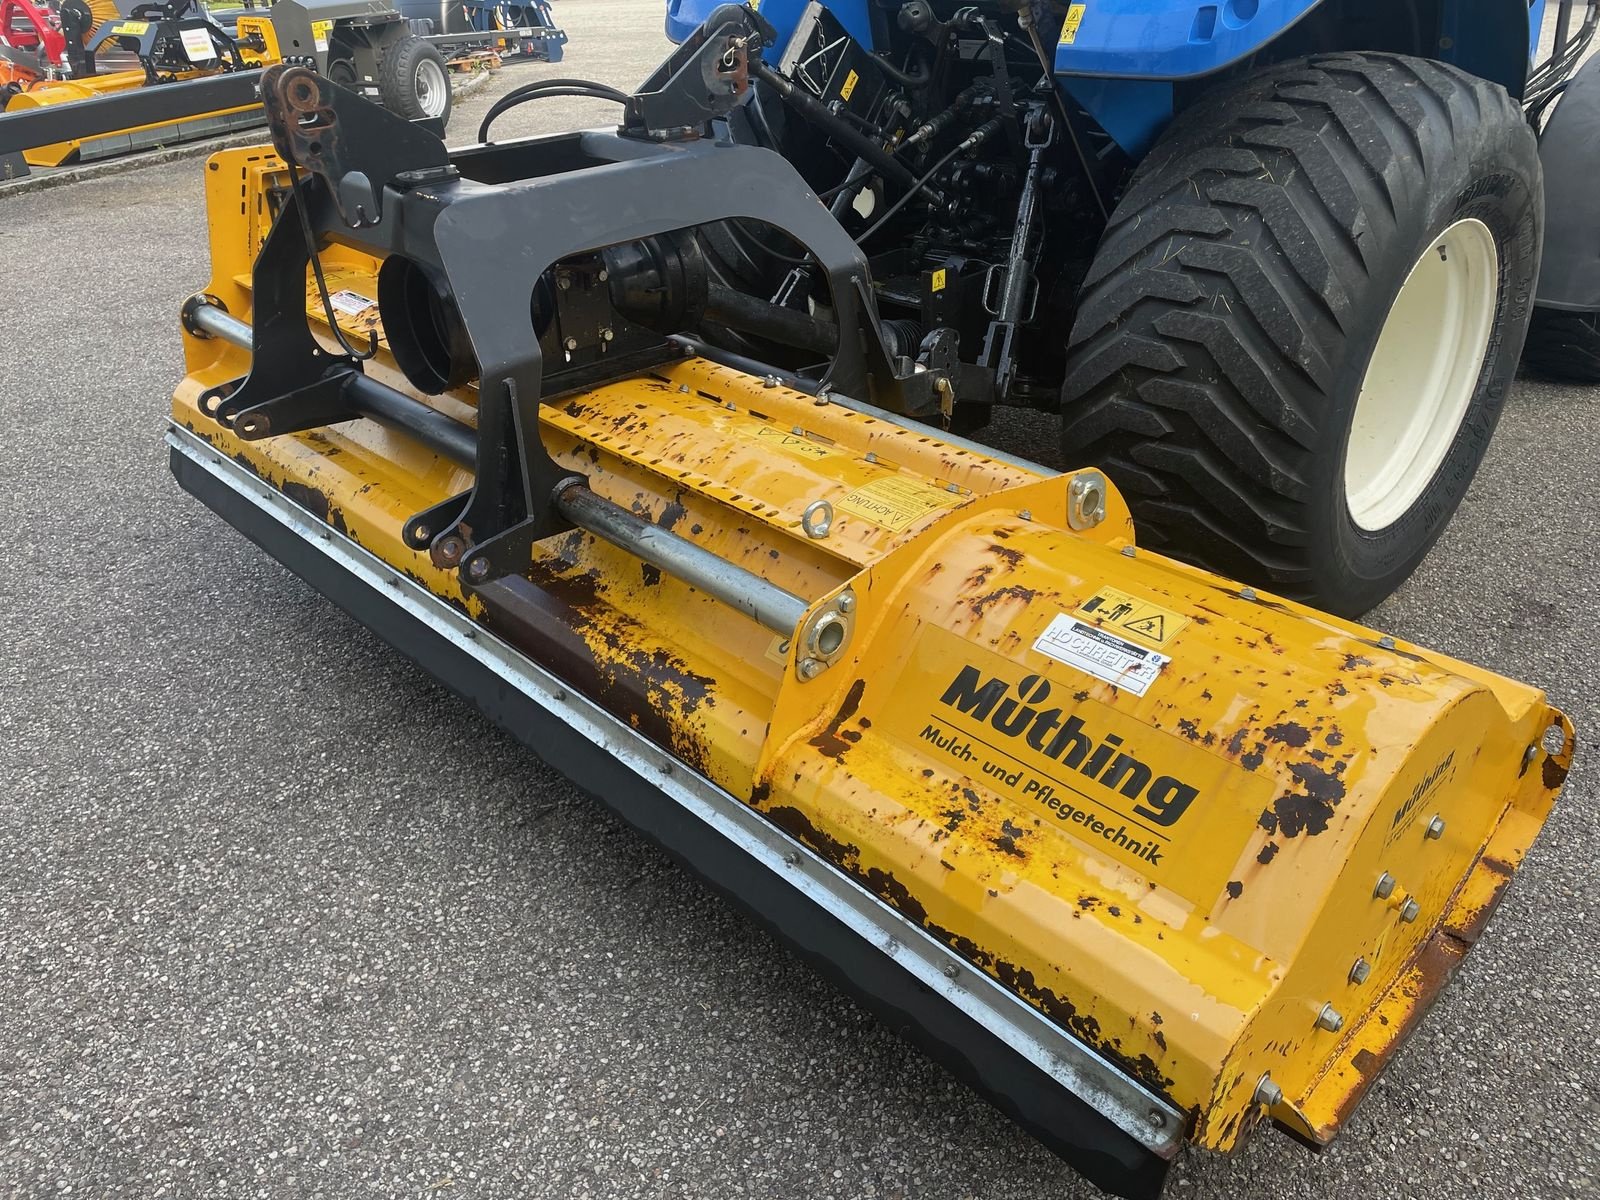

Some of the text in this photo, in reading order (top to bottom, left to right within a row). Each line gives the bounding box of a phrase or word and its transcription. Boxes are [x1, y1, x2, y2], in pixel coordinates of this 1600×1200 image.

[847, 494, 894, 516] ACHTUNG
[919, 724, 1164, 866] Mulch- und Pflegetechnik
[939, 664, 1200, 827] Müthing
[1391, 748, 1455, 830] Müthing
